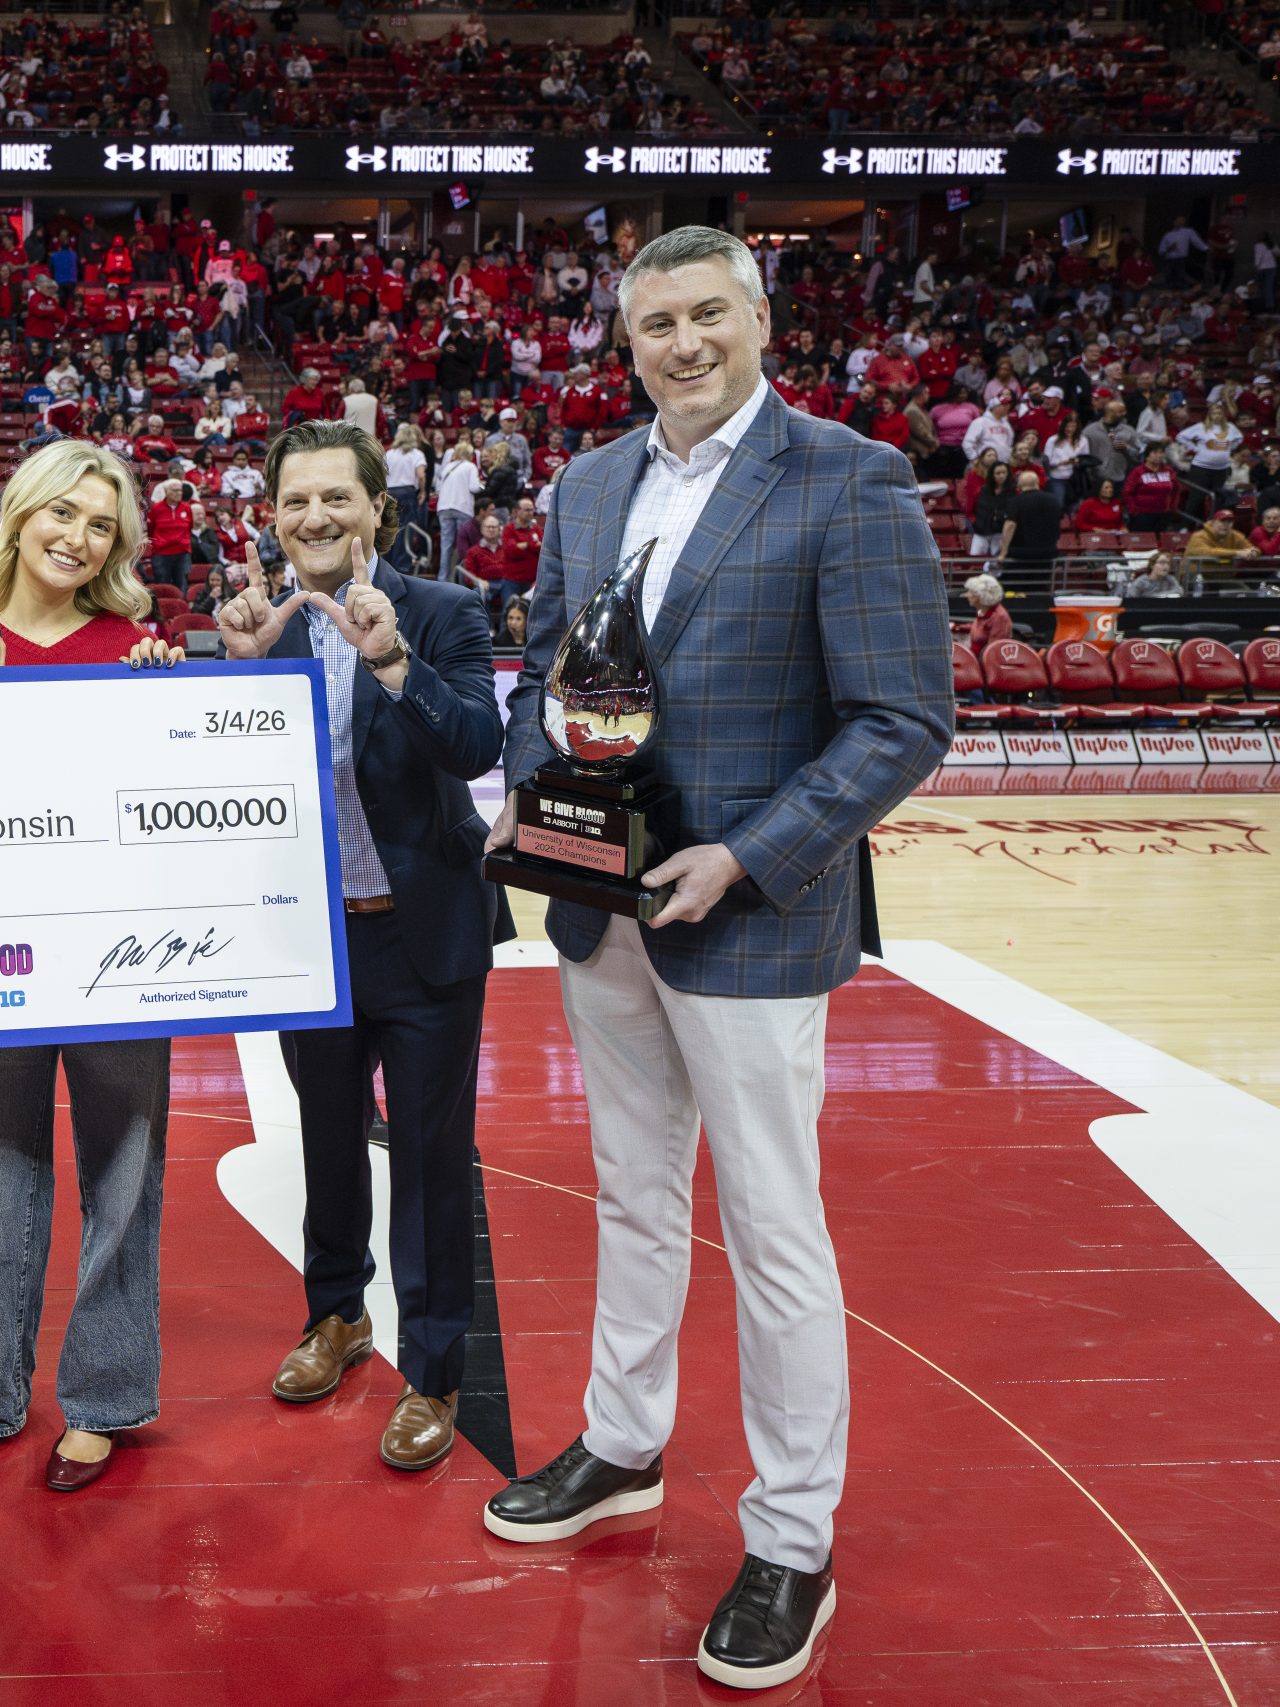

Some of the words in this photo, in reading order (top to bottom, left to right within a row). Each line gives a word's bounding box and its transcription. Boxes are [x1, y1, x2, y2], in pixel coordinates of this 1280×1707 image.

[151, 145, 209, 171] PROTECT
[211, 145, 242, 171] THIS
[392, 146, 449, 172] PROTECT
[451, 146, 482, 172] THIS
[630, 147, 689, 173] PROTECT
[690, 147, 721, 173] THIS
[867, 148, 925, 174] PROTECT
[927, 148, 957, 174] THIS
[1102, 149, 1158, 175] PROTECT
[1160, 149, 1190, 175] THIS
[169, 729, 196, 739] Date:
[205, 709, 286, 734] 3/4/26
[1008, 738, 1061, 756] HyVee
[1075, 737, 1128, 755] HyVee
[1140, 737, 1194, 755] HyVee
[1207, 736, 1262, 754] HyVee
[125, 797, 287, 835] $1,000,000
[539, 798, 553, 813] WE
[554, 802, 574, 818] GIVE
[575, 806, 606, 825] BLOOD
[552, 818, 579, 830] ABBOTT
[975, 819, 1267, 834] COURT
[522, 828, 563, 846] University
[566, 839, 575, 847] of
[576, 839, 620, 858] Wisconsin
[534, 842, 556, 853] 2025
[558, 847, 607, 866] Champions
[262, 894, 298, 905] Dollars
[139, 991, 196, 1003] Authorized
[198, 988, 248, 1001] Signature
